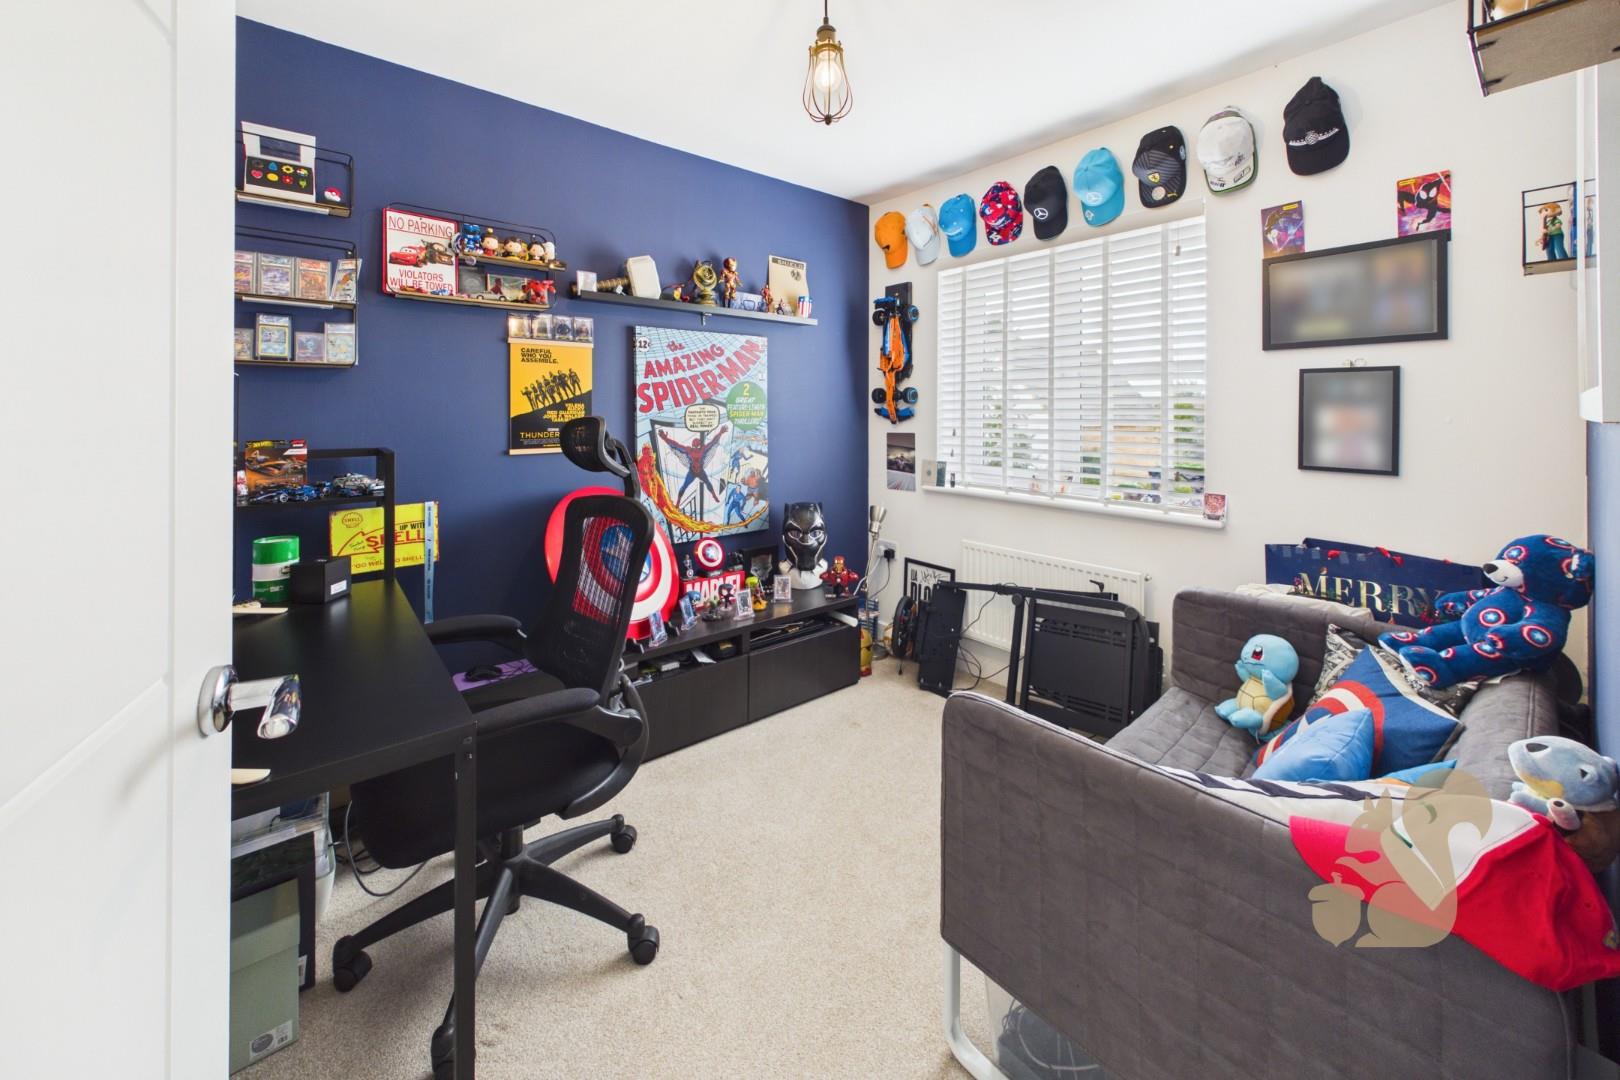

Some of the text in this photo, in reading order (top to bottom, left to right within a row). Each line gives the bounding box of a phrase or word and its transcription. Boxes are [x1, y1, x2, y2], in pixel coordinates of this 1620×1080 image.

[389, 215, 453, 239] NO PARKING
[399, 270, 443, 283] VIOLATORS
[643, 343, 725, 379] AMAZING
[636, 339, 762, 414] SPIDER-MAN
[743, 383, 750, 397] 2
[366, 530, 425, 548] SELL
[1298, 572, 1445, 618] MERRY
